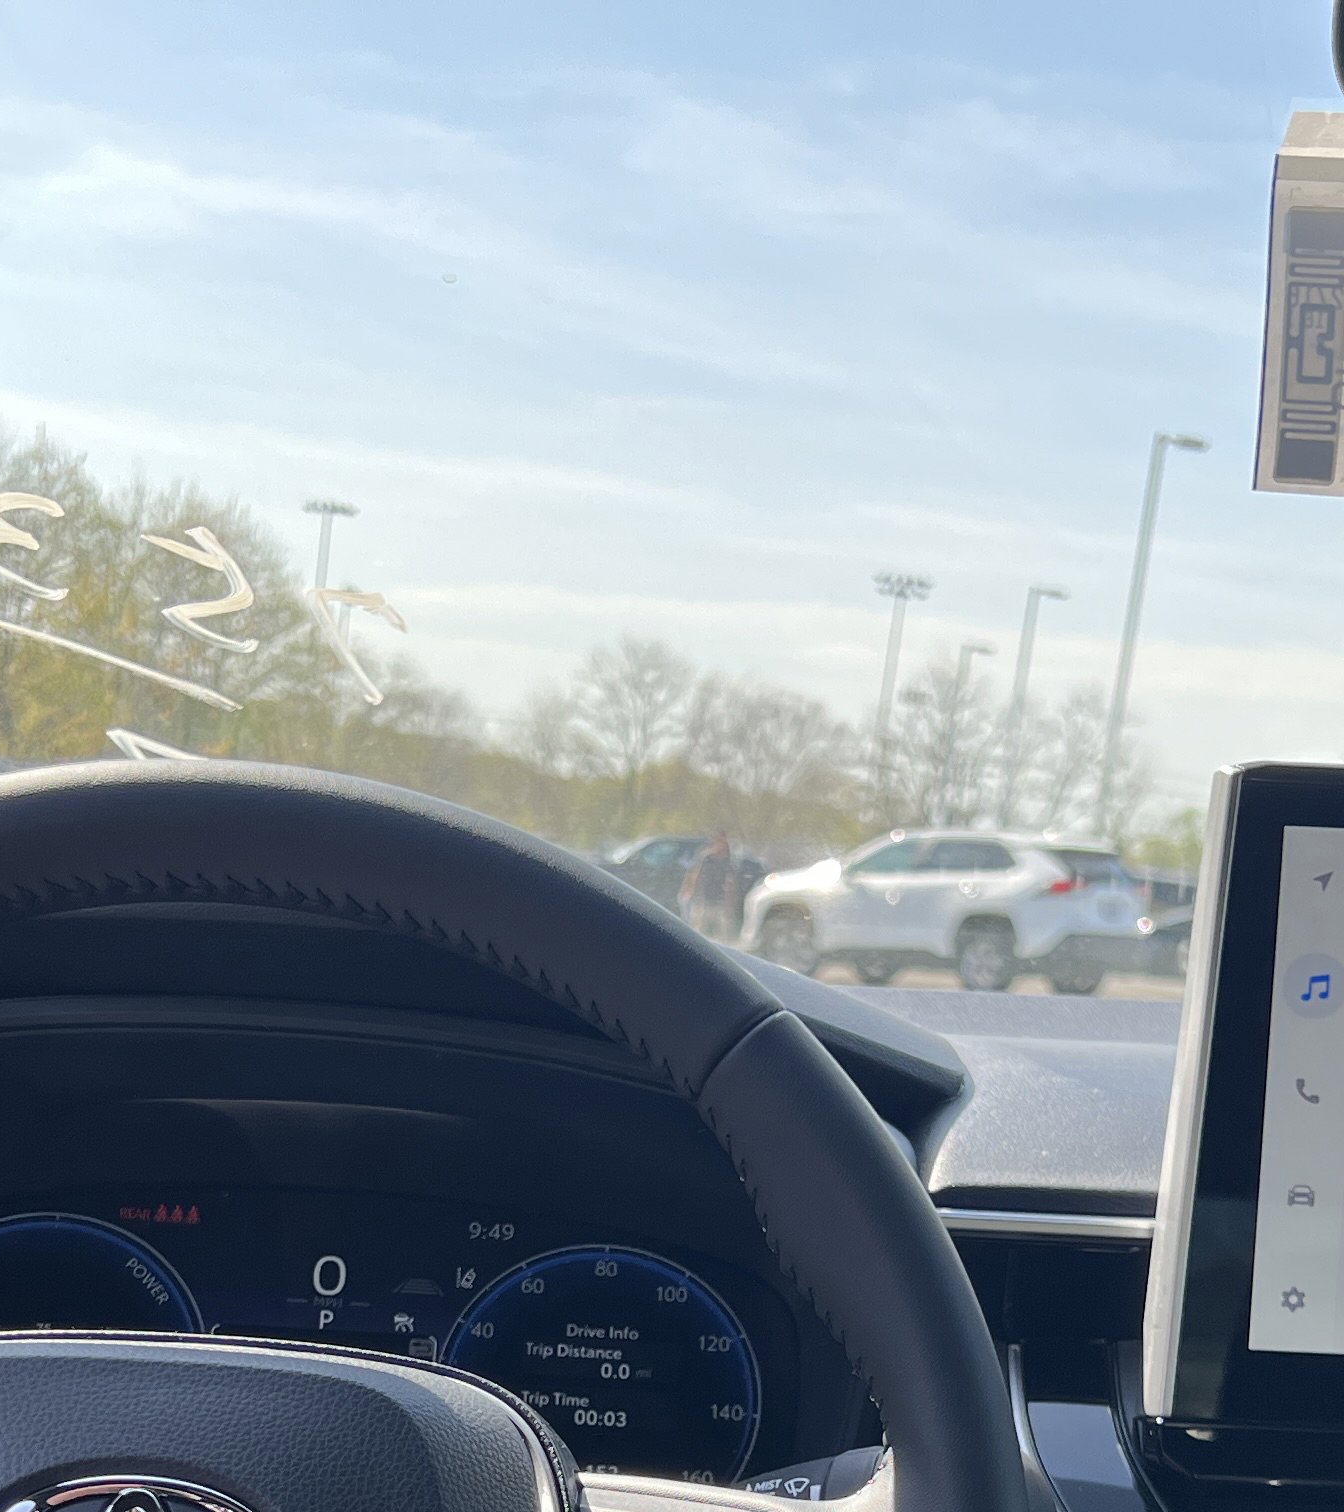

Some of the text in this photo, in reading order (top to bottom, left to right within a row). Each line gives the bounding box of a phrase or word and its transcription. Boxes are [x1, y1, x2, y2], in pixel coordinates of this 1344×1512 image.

[467, 1221, 516, 1241] 9:49
[594, 1260, 618, 1278] 80
[123, 1256, 171, 1306] POWER
[520, 1278, 545, 1295] 60
[656, 1285, 688, 1303] 100
[319, 1309, 334, 1330] P
[471, 1321, 495, 1340] 40
[566, 1324, 640, 1341] Drive Info
[525, 1342, 623, 1361] Trip Distance
[700, 1336, 731, 1353] 120
[600, 1363, 631, 1380] 0.0
[520, 1390, 590, 1408] Trip Time
[573, 1409, 628, 1428] 00:03
[711, 1403, 743, 1421] 140
[754, 1478, 783, 1492] MIST
